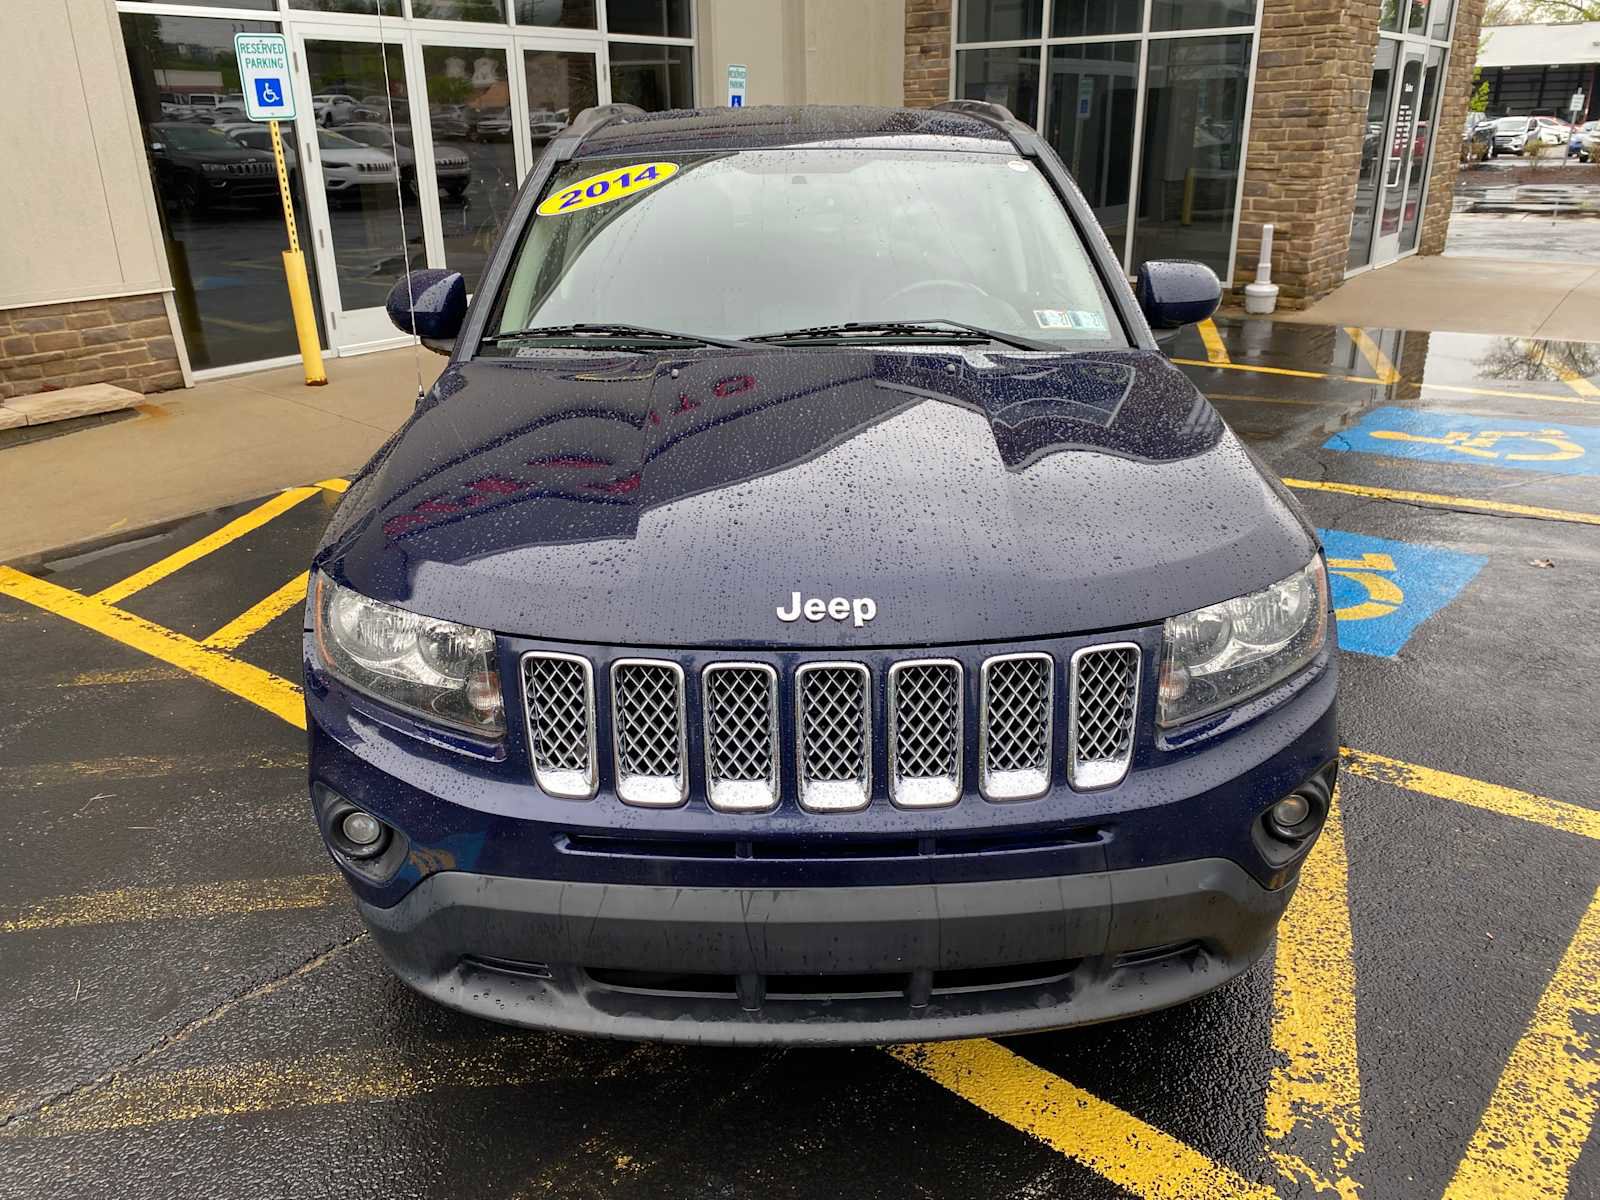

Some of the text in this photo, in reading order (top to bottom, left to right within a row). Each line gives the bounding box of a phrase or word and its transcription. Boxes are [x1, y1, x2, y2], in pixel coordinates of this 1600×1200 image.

[240, 42, 284, 55] RESERVED
[245, 57, 284, 69] PARKING
[558, 165, 661, 210] 2014
[776, 591, 877, 628] Jeep
